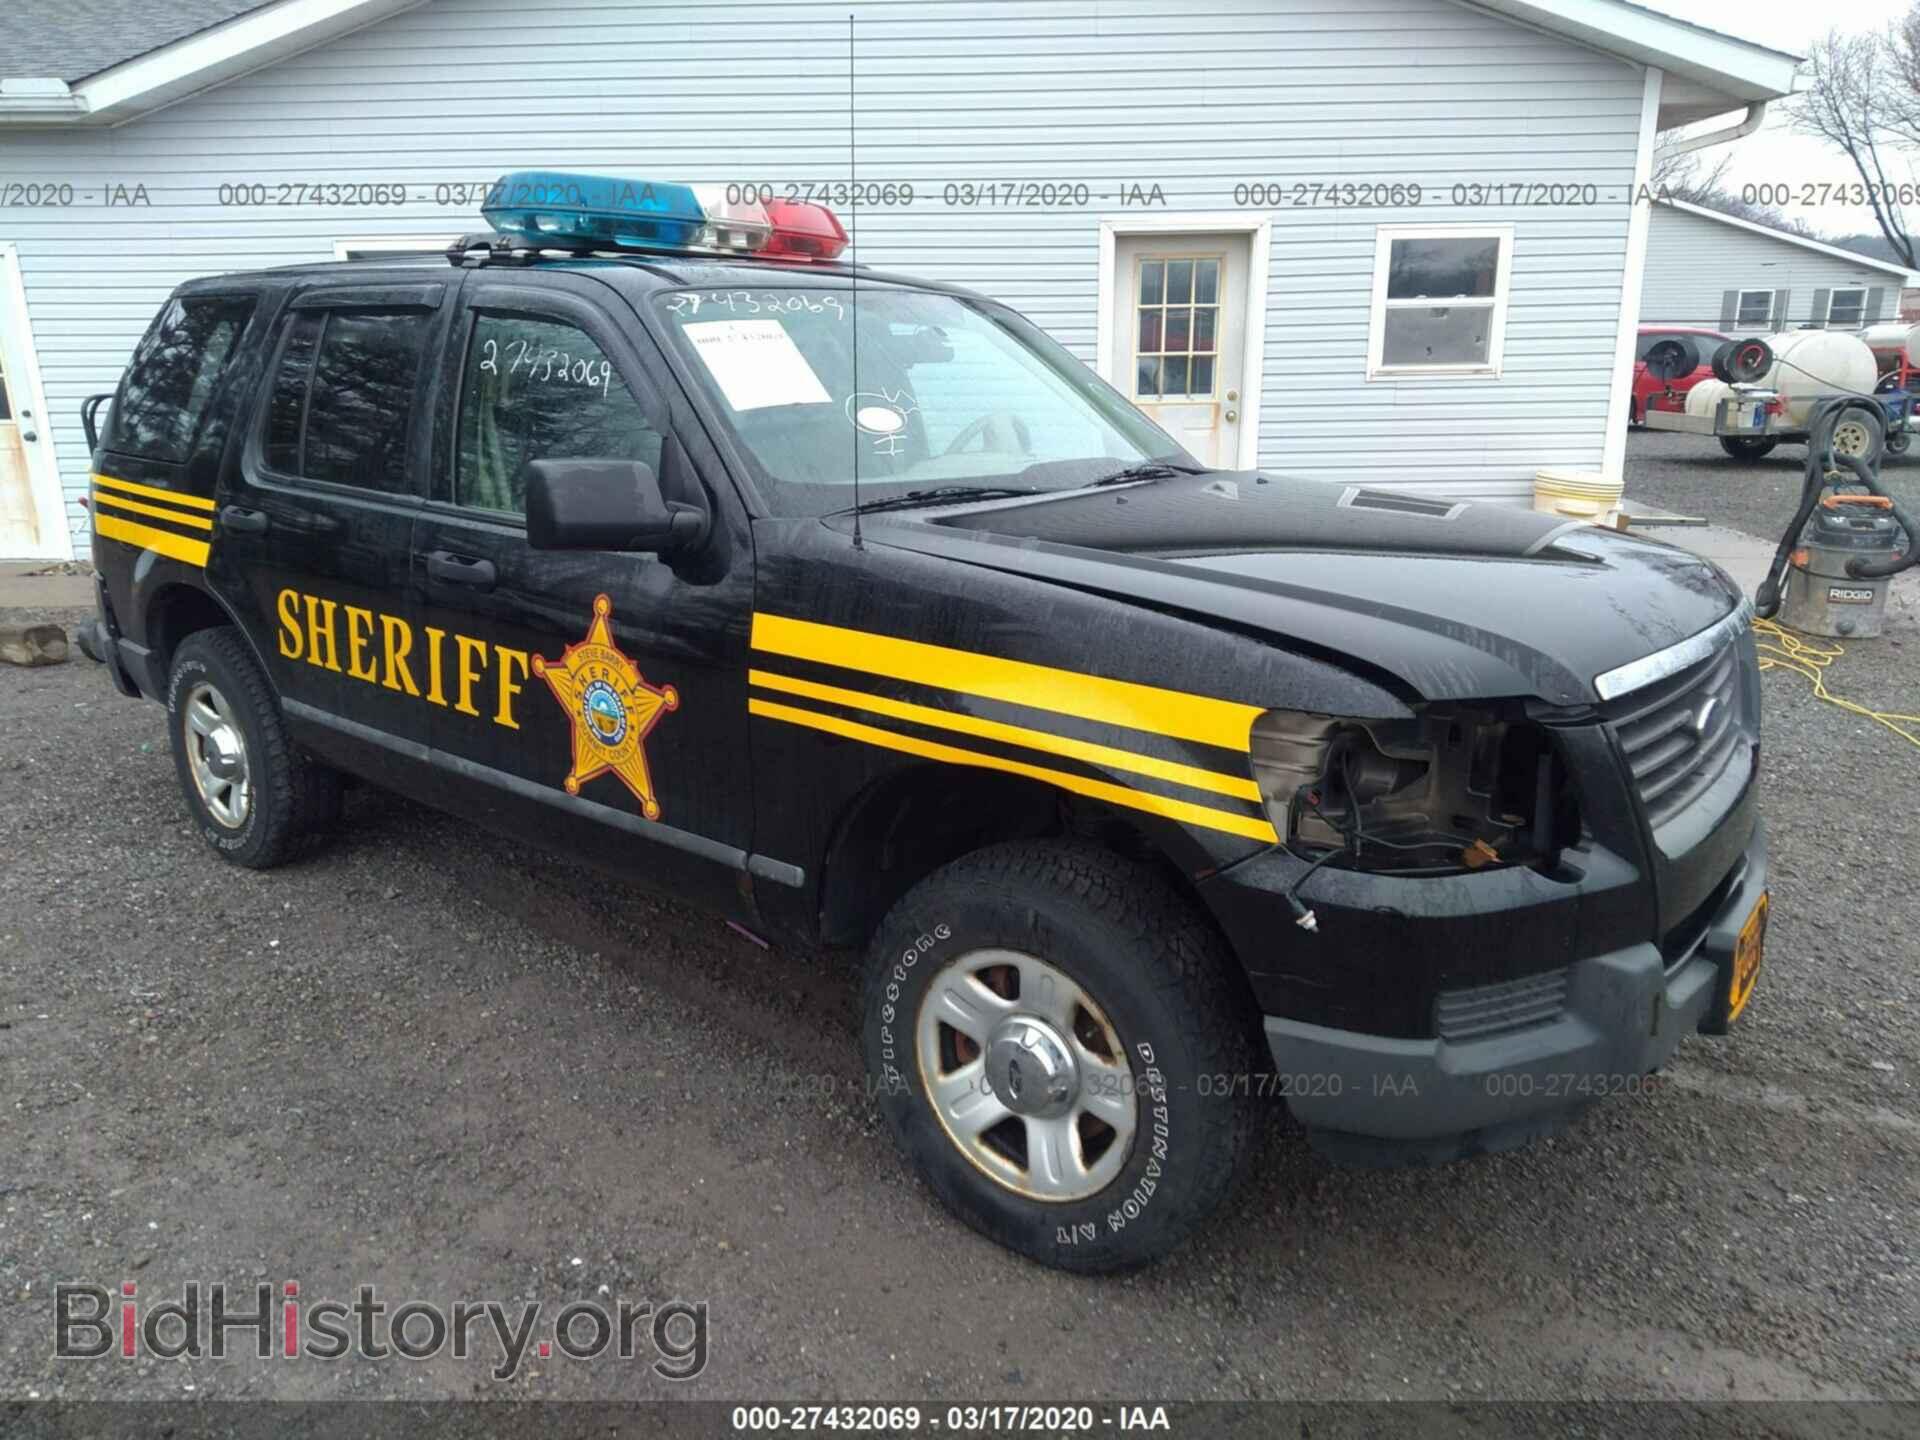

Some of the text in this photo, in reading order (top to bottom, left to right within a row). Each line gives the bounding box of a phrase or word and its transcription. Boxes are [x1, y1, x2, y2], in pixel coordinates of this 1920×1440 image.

[1830, 588, 1873, 600] RIDGID
[277, 588, 530, 730] SHERIFF
[574, 666, 635, 715] SHERIFF
[1056, 1042, 1169, 1245] DESTINATION A/T
